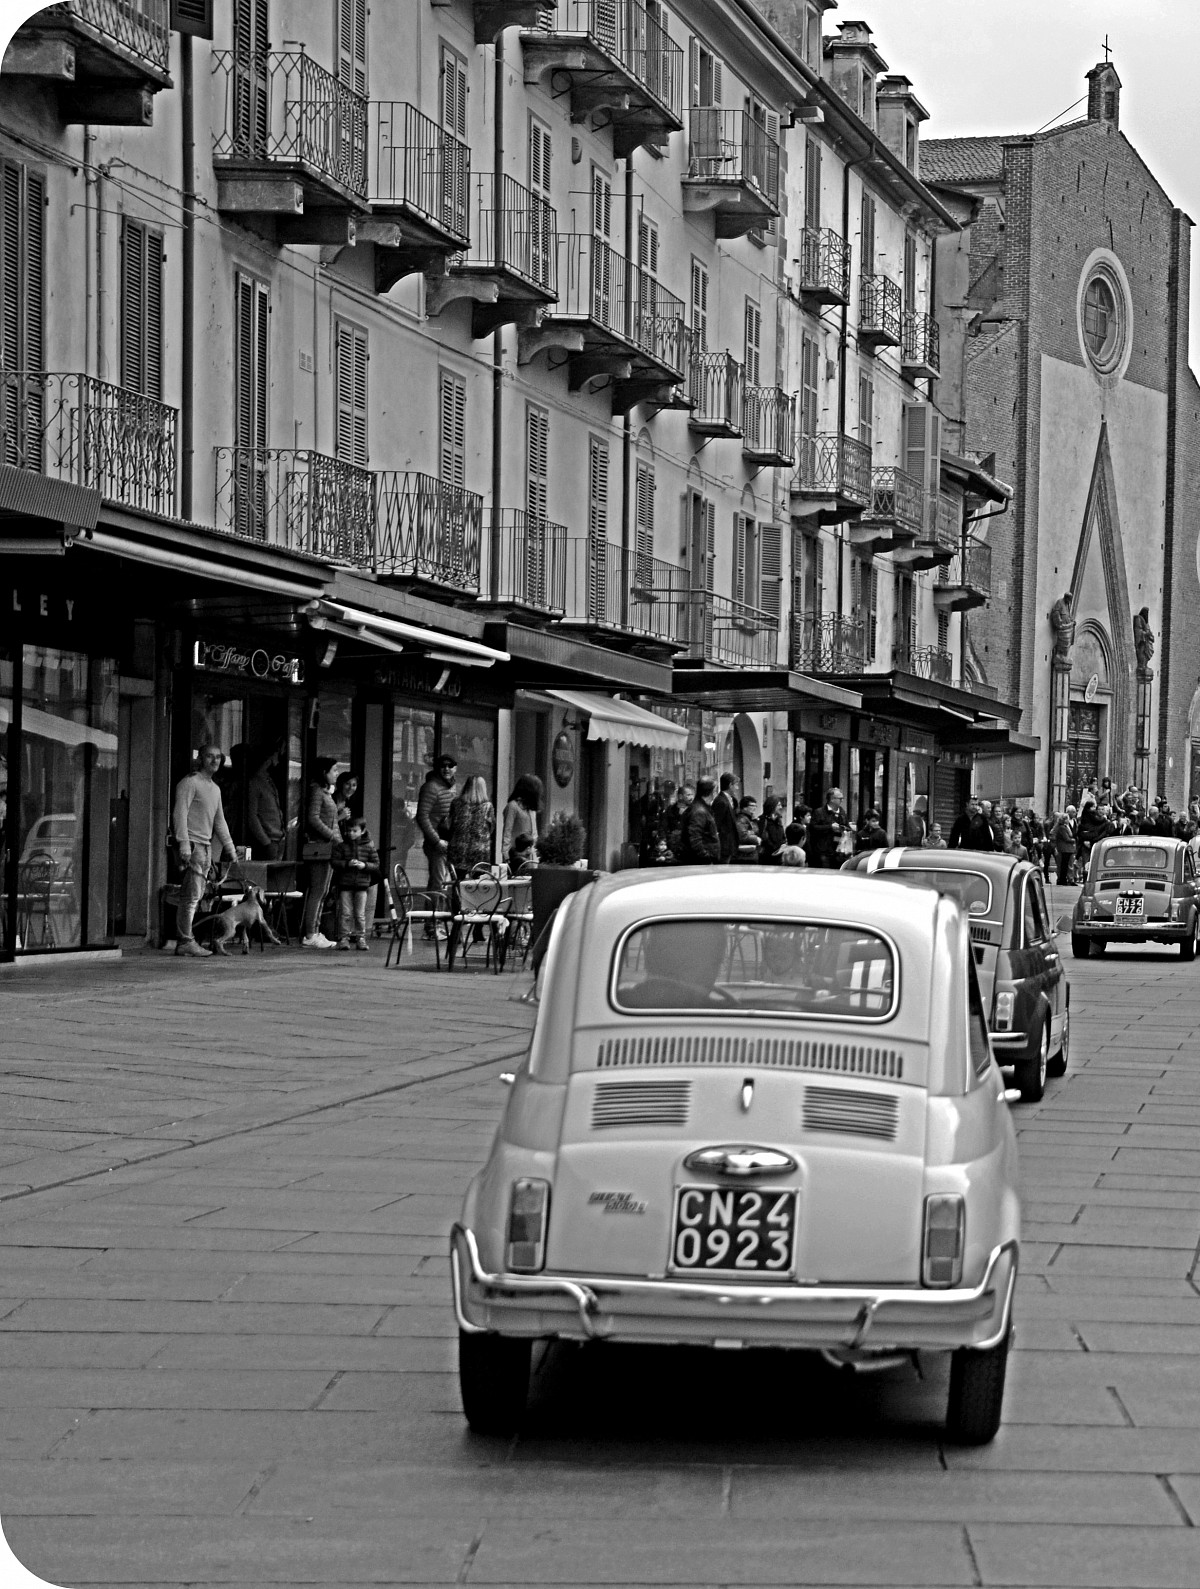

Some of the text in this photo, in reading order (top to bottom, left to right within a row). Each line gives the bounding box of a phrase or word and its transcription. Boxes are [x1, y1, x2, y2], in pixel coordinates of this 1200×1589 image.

[1118, 898, 1142, 906] CN34
[1118, 906, 1142, 914] 8776
[680, 1190, 790, 1228] CN24
[676, 1228, 789, 1268] 0923
